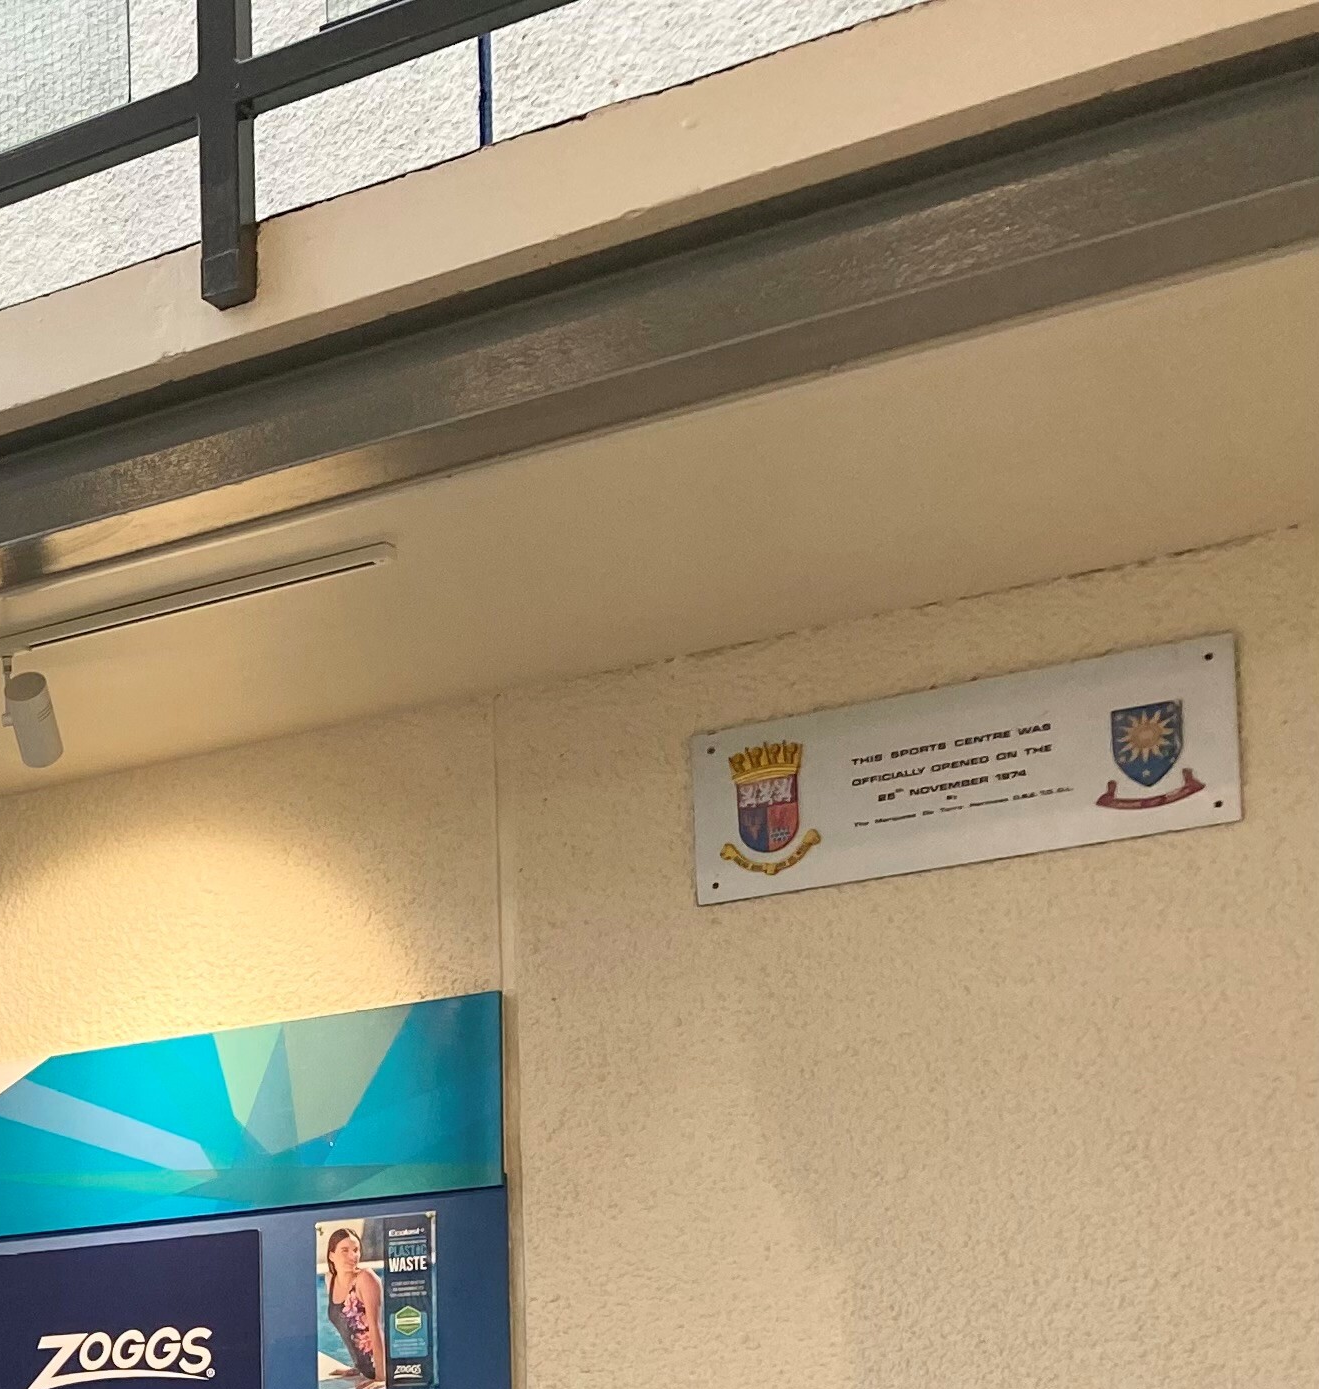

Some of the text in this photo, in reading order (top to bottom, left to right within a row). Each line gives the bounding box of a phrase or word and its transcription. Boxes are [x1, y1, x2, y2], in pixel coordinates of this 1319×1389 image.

[851, 723, 1051, 766] THIS SPORTS CENTRE WAS
[851, 744, 1053, 787] OFFICIALLY OPENED ON THE
[909, 776, 989, 796] NOVEMBER
[995, 769, 1027, 780] 1974
[389, 1256, 427, 1272] WASTE
[394, 1363, 422, 1379] ZOGGS
